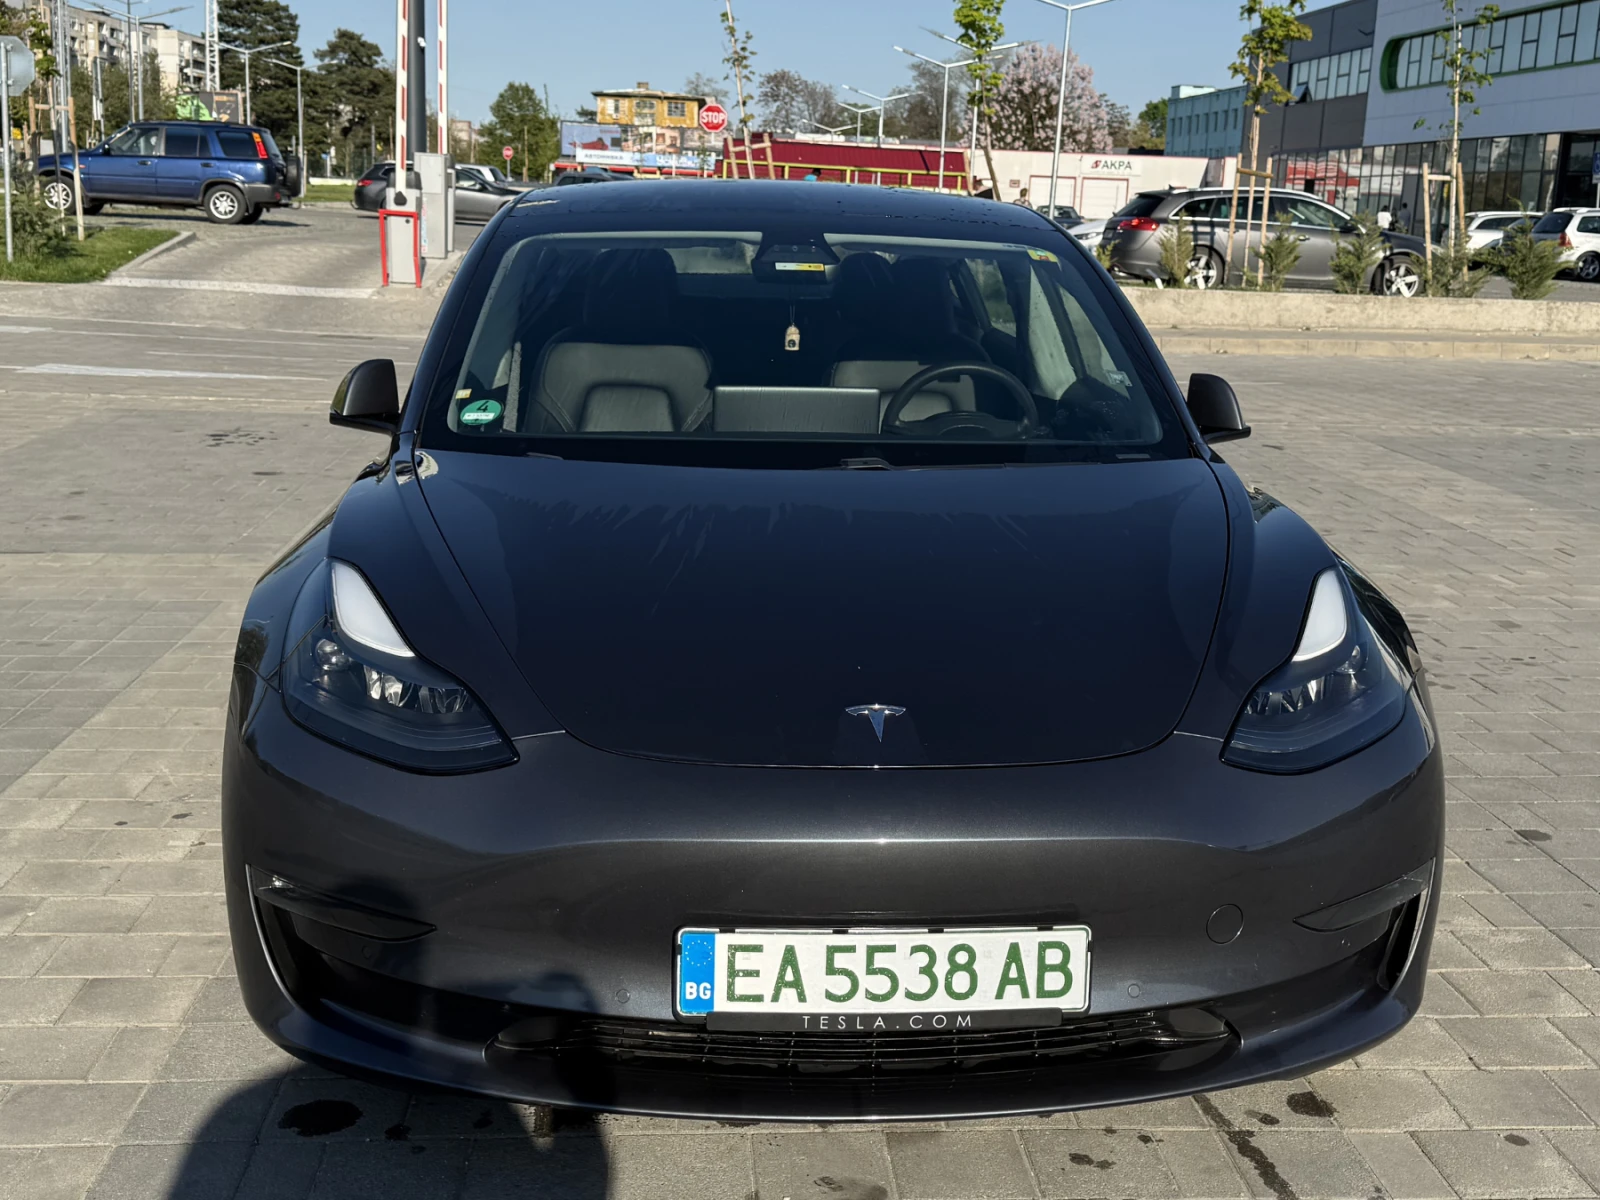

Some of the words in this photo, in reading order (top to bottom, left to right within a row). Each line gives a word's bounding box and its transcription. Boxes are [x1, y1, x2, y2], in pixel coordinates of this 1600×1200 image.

[701, 111, 726, 124] STOP
[476, 400, 489, 412] 4
[727, 944, 807, 1003] EA
[825, 943, 978, 1003] 5538
[995, 941, 1073, 1000] AB
[685, 982, 712, 1000] BG
[802, 1015, 972, 1029] TESLA.COM
